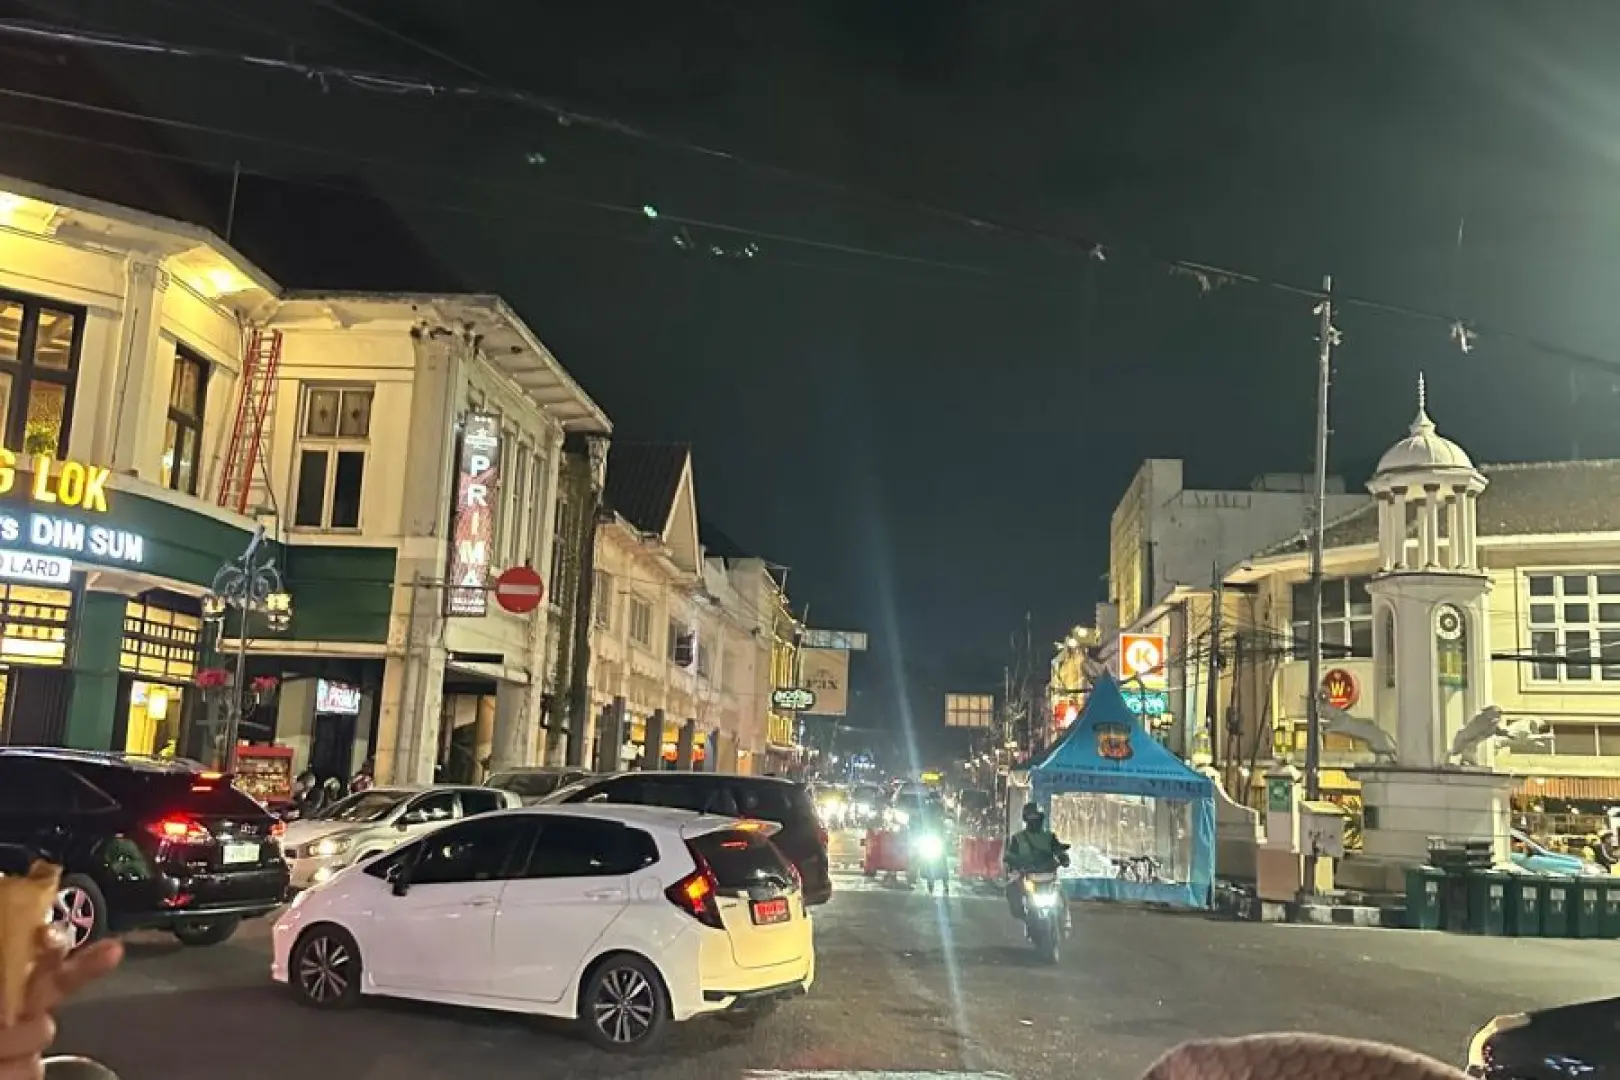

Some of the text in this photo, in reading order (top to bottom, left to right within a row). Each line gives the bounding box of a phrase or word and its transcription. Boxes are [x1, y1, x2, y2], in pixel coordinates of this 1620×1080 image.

[33, 453, 110, 512] LOK
[31, 514, 84, 551] DIM
[89, 526, 143, 562] SUM
[459, 454, 491, 586] PRIMA
[10, 556, 60, 577] LARD
